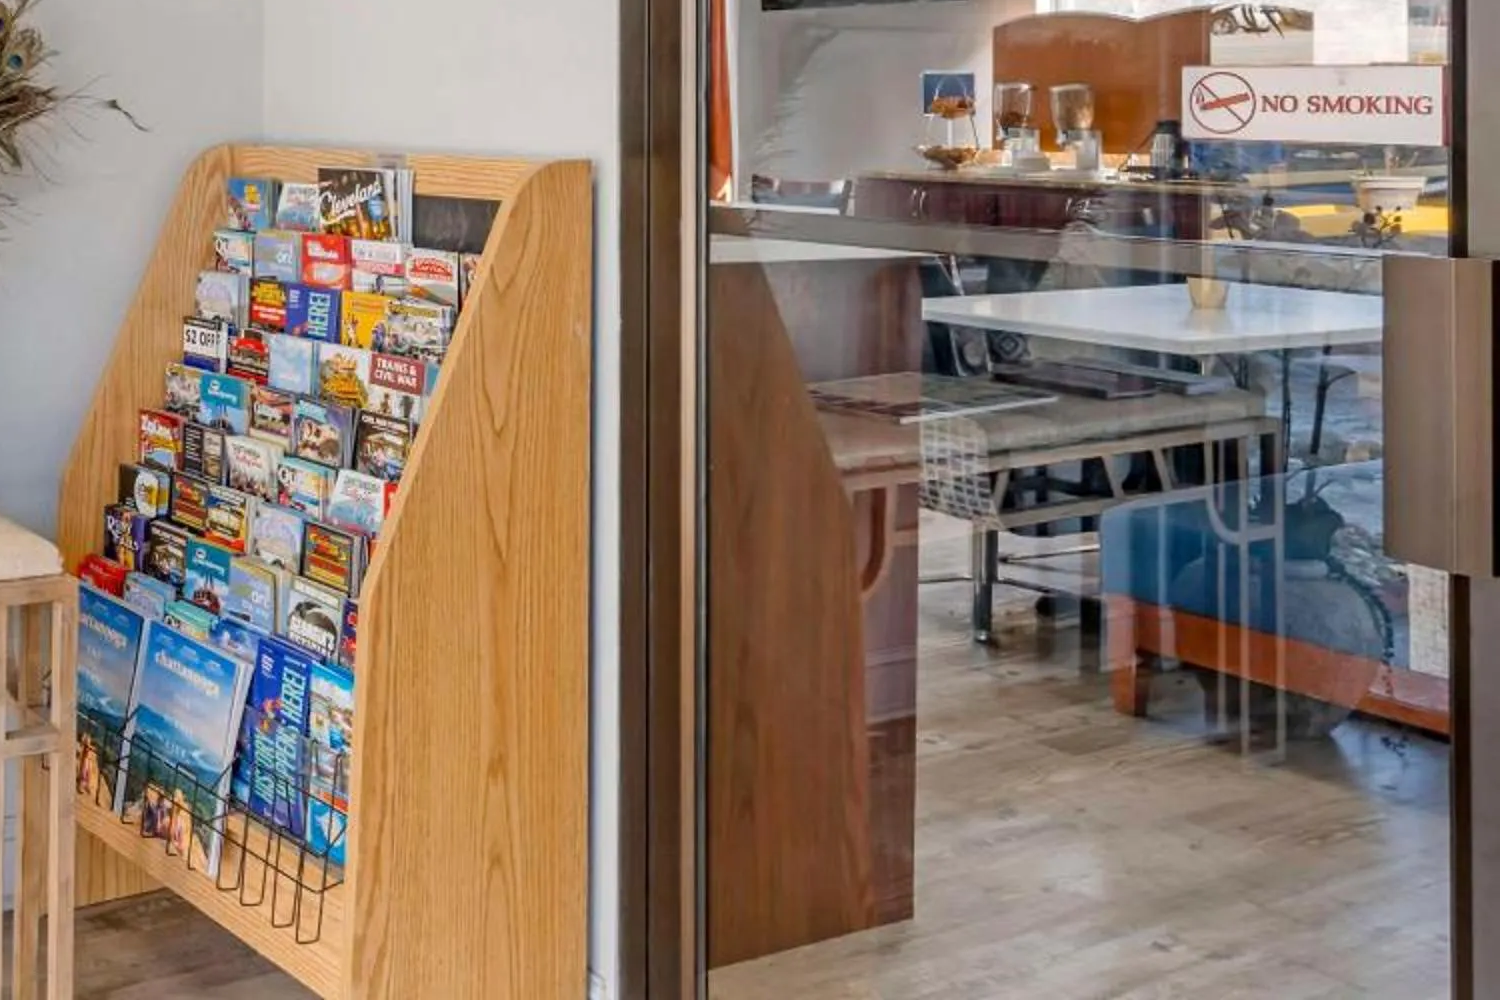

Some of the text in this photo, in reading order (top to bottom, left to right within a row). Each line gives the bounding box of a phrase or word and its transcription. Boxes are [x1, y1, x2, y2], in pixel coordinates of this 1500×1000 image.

[1261, 95, 1433, 115] NO SMOKING
[319, 172, 383, 224] Cleveland
